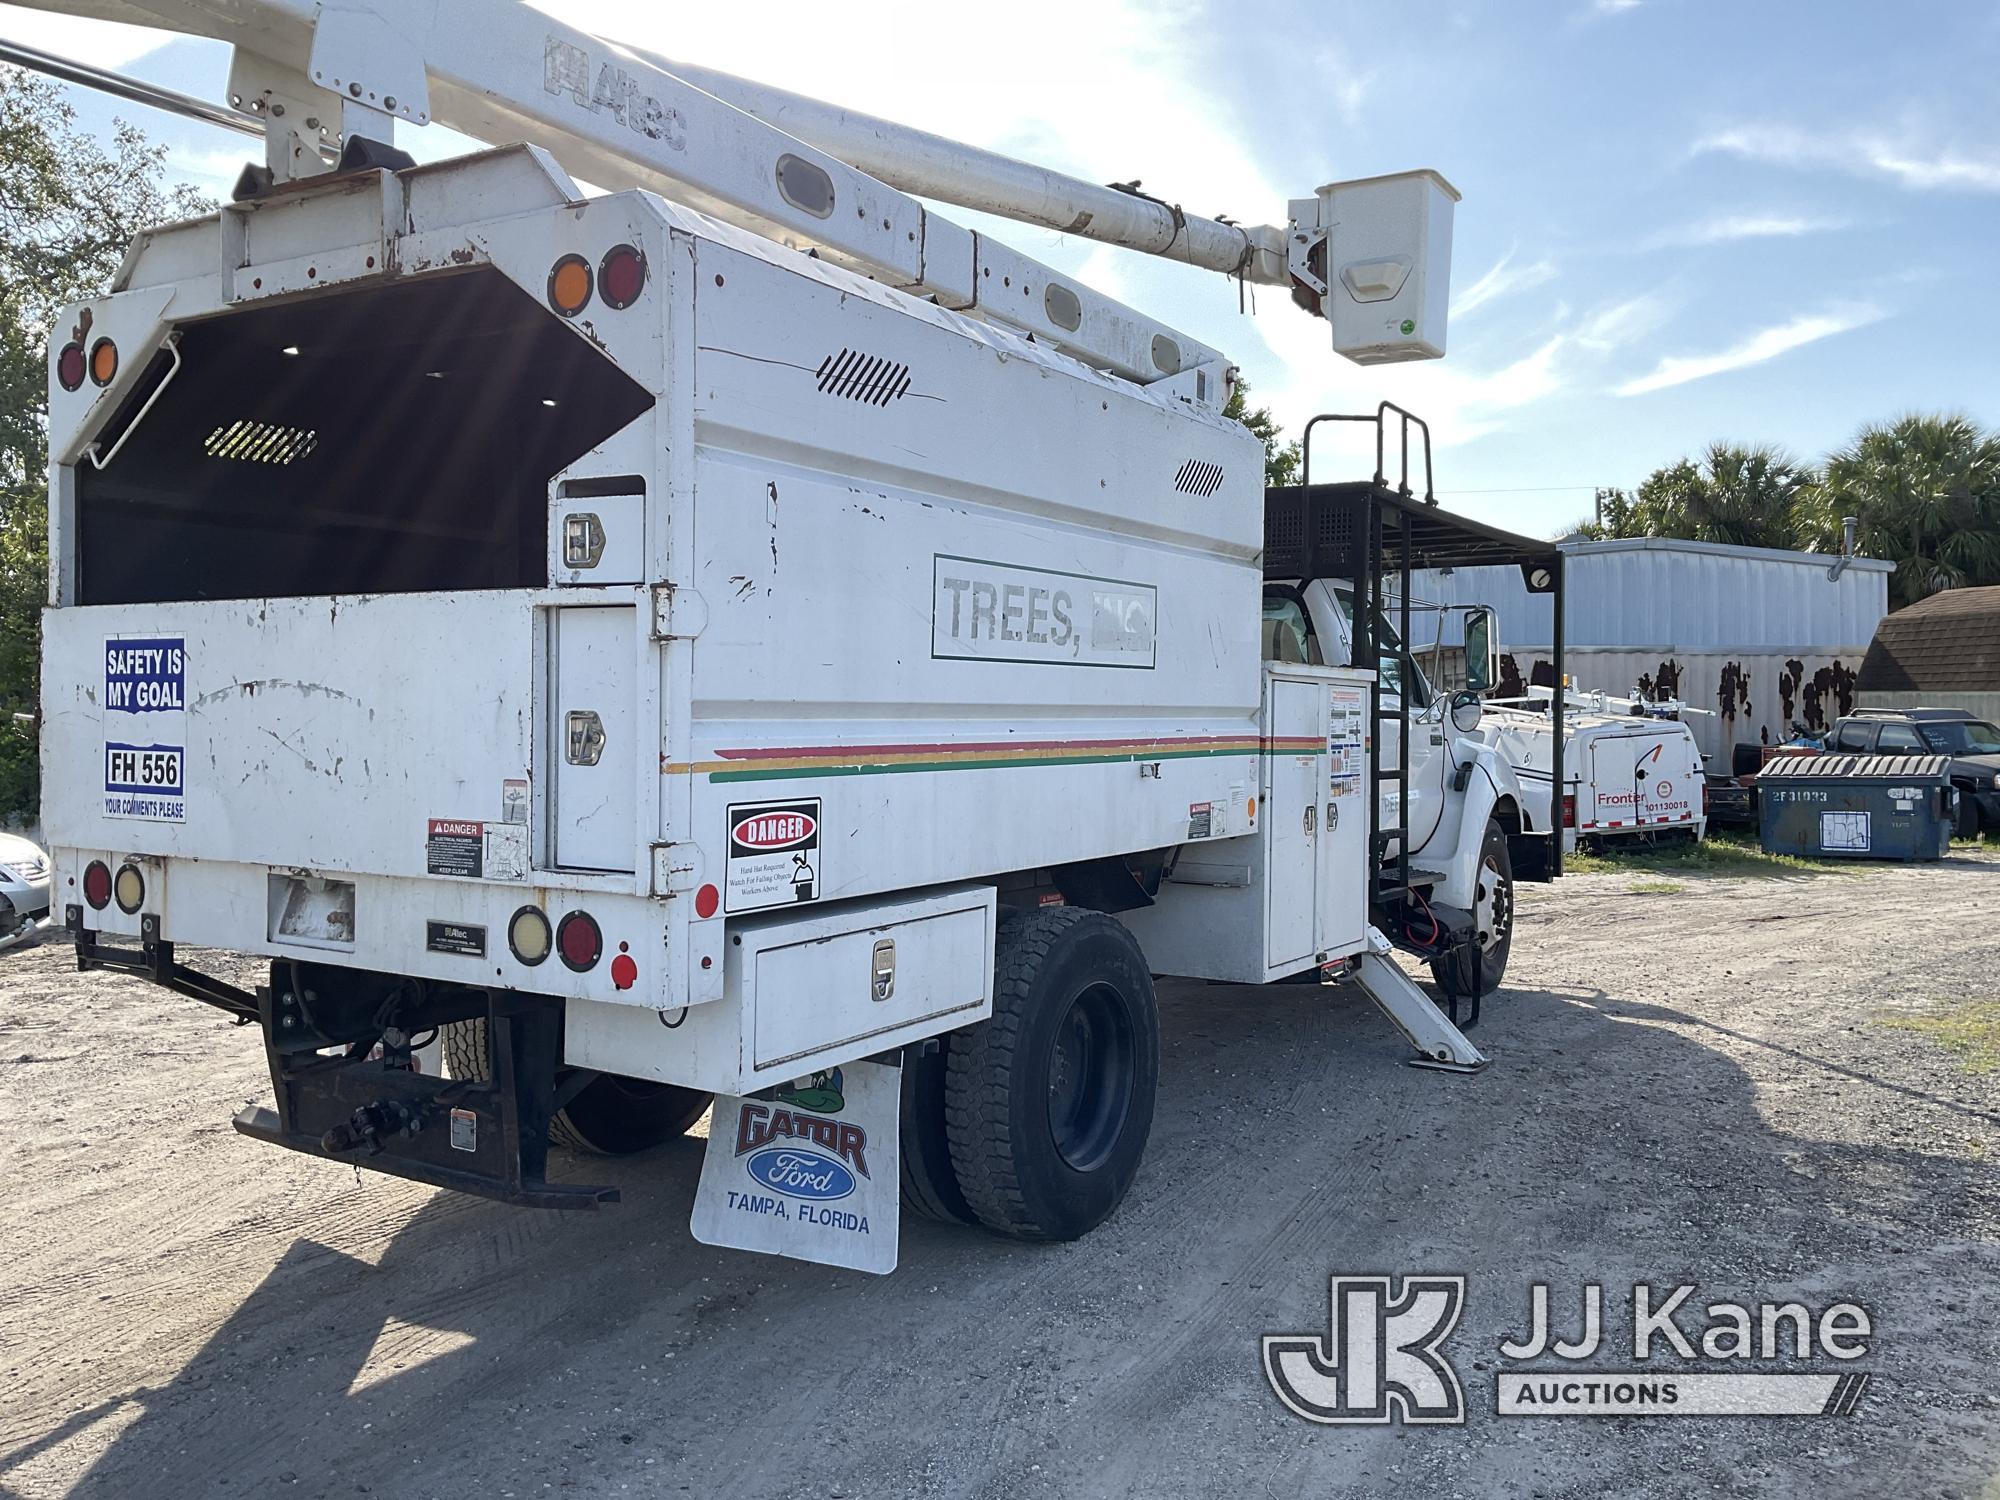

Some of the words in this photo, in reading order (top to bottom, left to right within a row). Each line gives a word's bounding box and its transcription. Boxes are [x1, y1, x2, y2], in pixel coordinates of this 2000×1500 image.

[943, 577, 1081, 657] TREES,
[108, 649, 164, 675] SAFETY
[167, 648, 182, 675] IS
[108, 681, 133, 707] MY
[136, 681, 182, 707] GOAL
[111, 752, 136, 783] FH
[142, 753, 177, 785] 556
[105, 798, 122, 814] YOUR
[122, 799, 158, 817] COMMENTS
[158, 801, 184, 818] PLEASE
[1645, 801, 1689, 812] 101130018
[443, 823, 478, 835] DANGER
[747, 817, 804, 843] DANGER
[729, 879, 746, 887] Watch
[746, 876, 756, 885] For
[756, 875, 773, 884] Falling
[740, 866, 753, 875] Hard
[753, 865, 763, 873] Hat
[763, 863, 786, 872] Required
[741, 888, 762, 896] Workers
[762, 885, 779, 893] Above
[451, 928, 468, 939] Altec
[735, 1103, 871, 1181] GATOR
[768, 1153, 834, 1192] Ford
[727, 1191, 791, 1222] TAMPA,
[798, 1205, 870, 1234] FLORIDA
